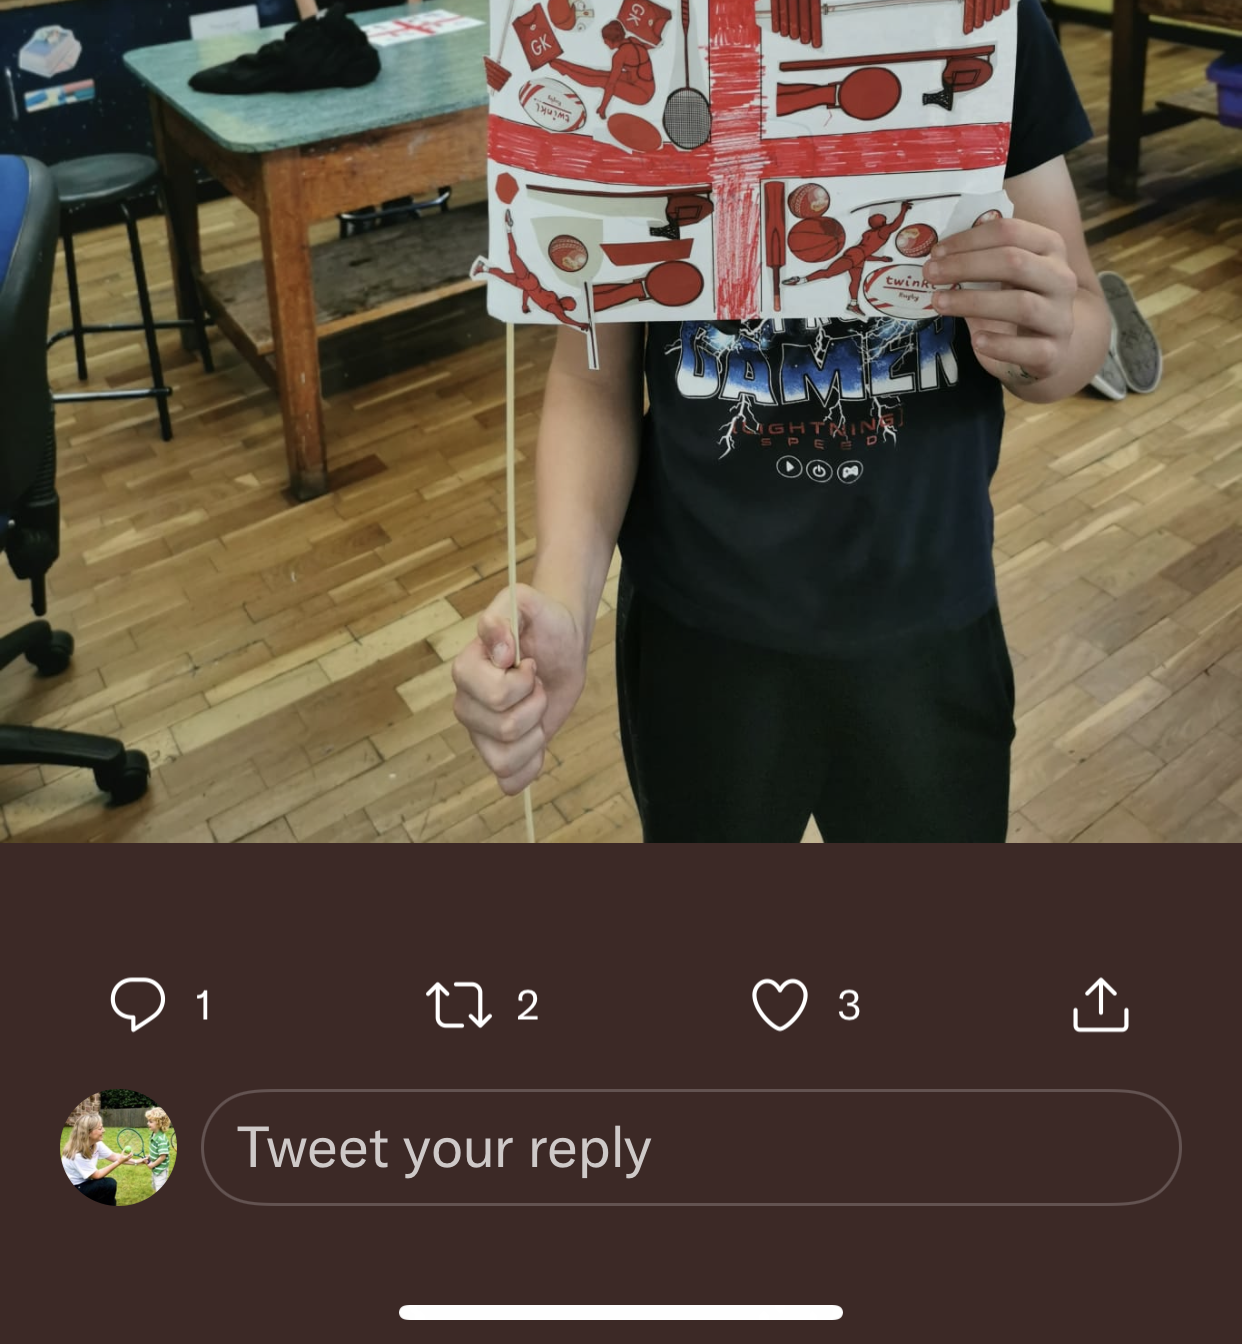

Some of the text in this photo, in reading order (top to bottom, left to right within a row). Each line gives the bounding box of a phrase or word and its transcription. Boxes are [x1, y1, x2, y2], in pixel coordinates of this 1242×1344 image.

[626, 3, 646, 27] GK
[530, 33, 552, 56] GK
[535, 102, 570, 123] twinkl
[760, 435, 878, 451] SPEED
